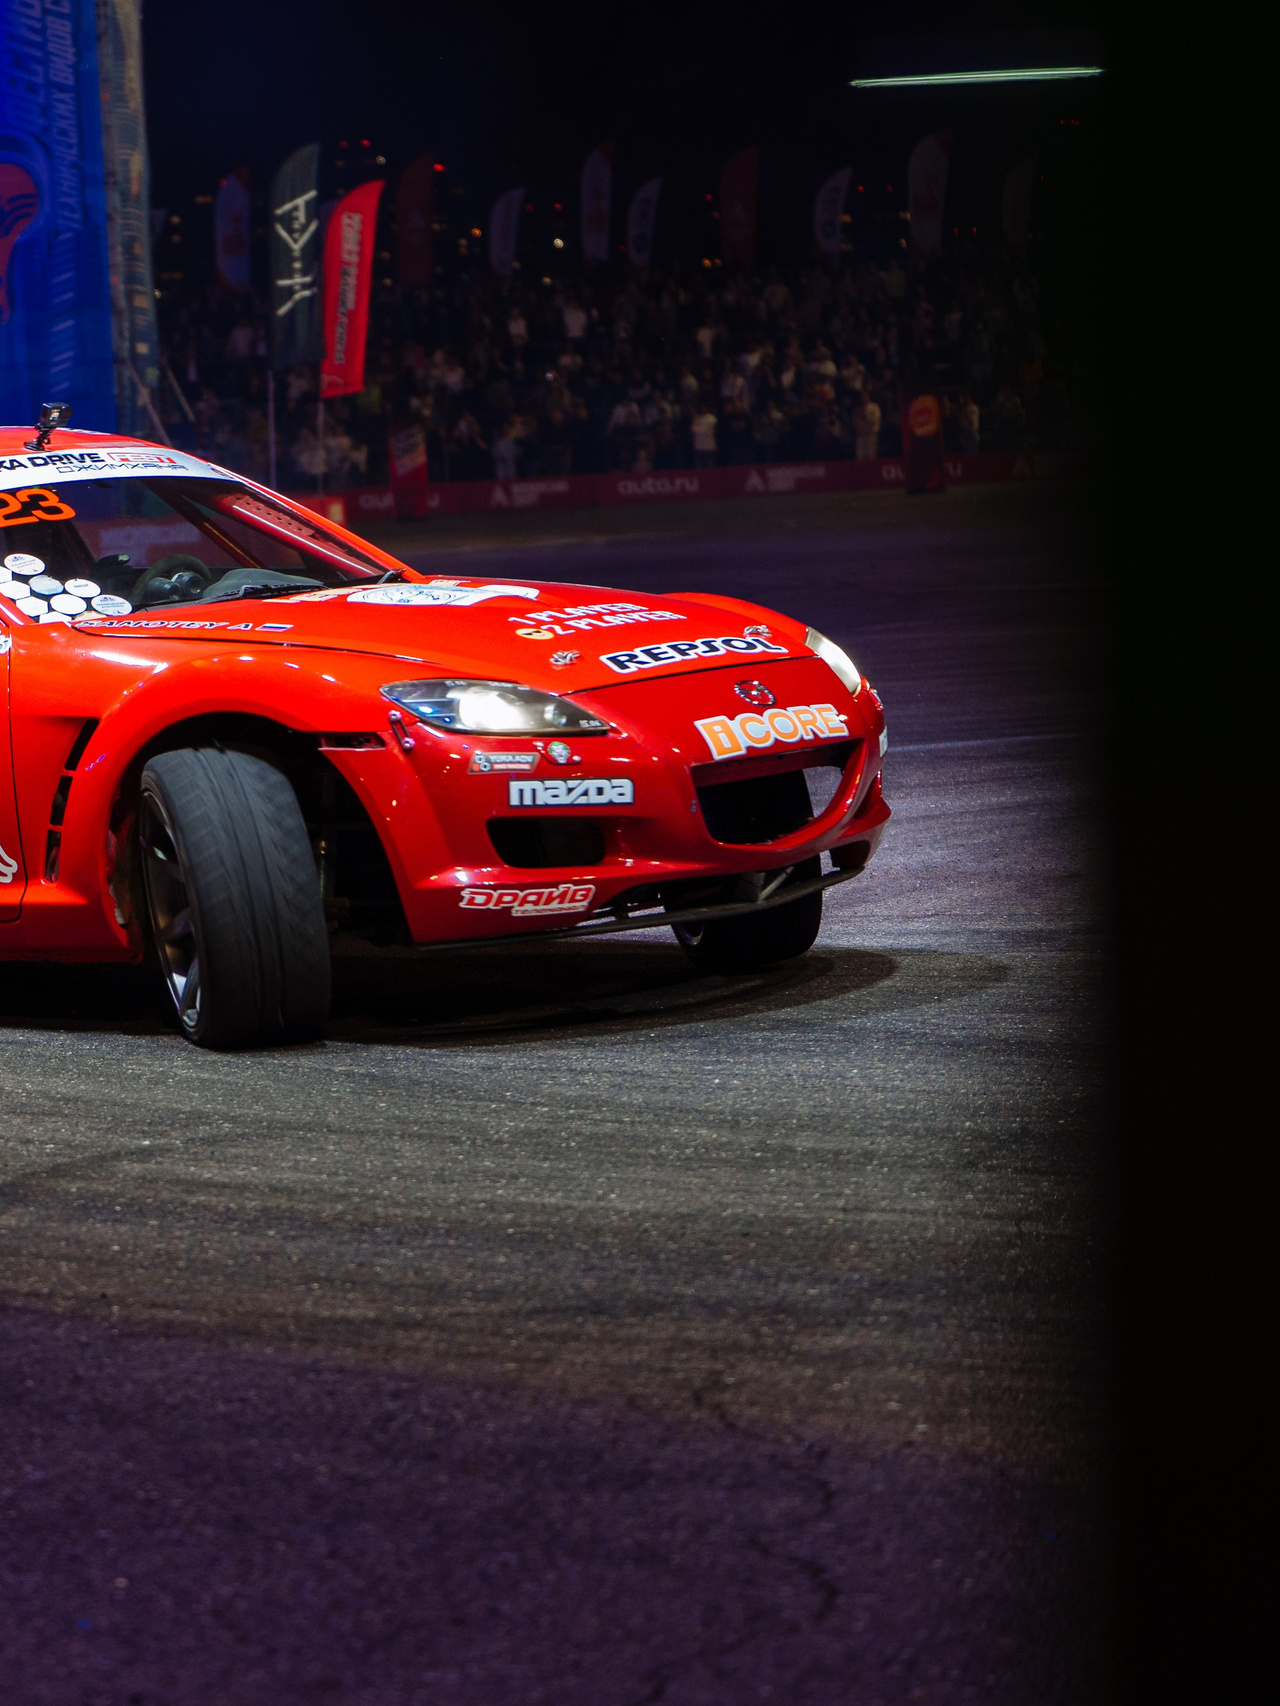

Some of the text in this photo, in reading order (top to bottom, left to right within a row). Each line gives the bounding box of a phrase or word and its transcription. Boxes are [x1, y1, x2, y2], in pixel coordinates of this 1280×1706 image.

[27, 451, 106, 469] DRIVE
[617, 477, 699, 495] auto.ru
[508, 602, 650, 625] 1 PLAYER
[540, 610, 687, 636] 2 PLAYER
[603, 637, 785, 672] REPSOL
